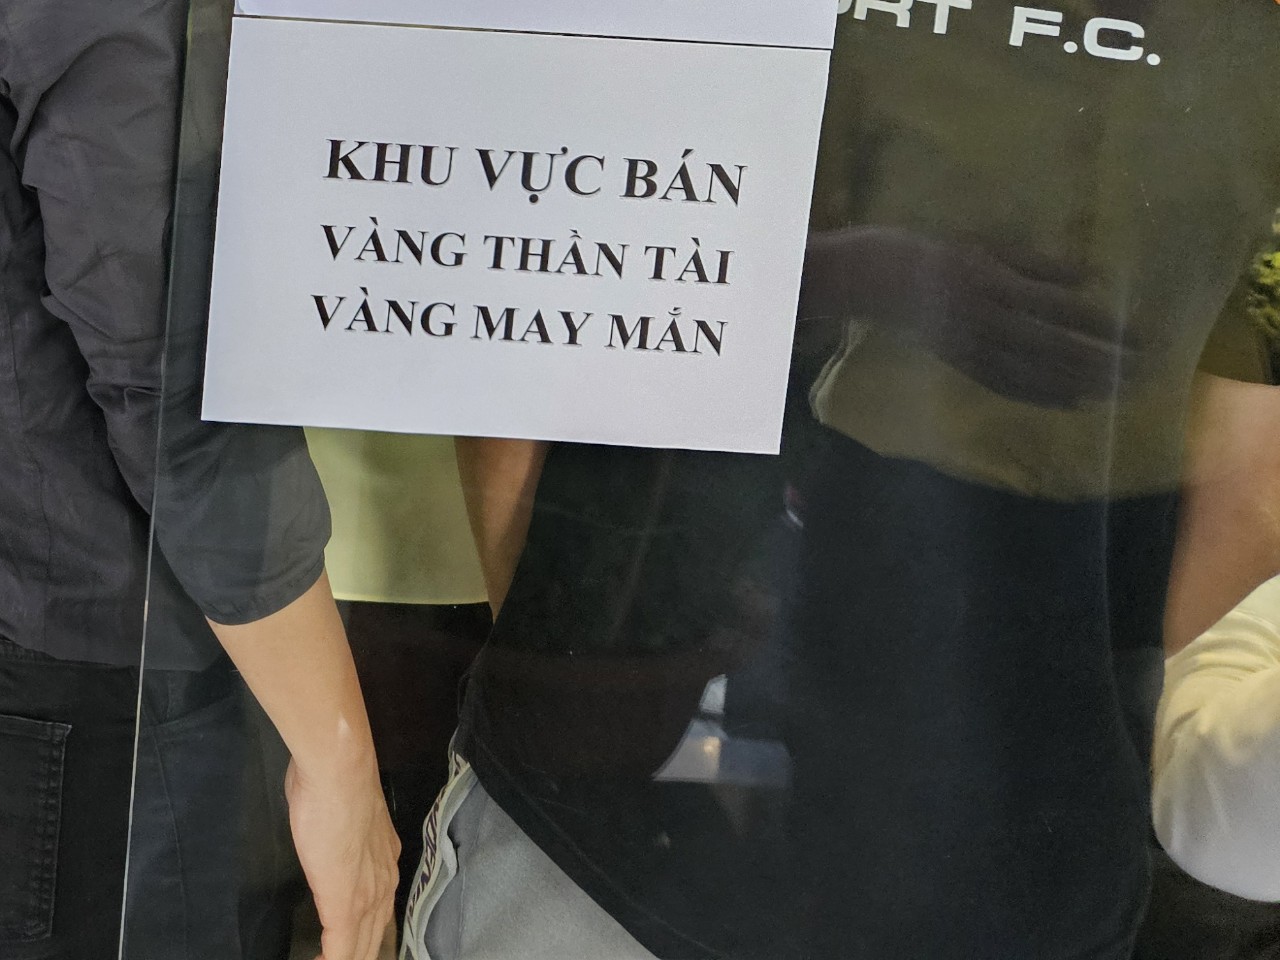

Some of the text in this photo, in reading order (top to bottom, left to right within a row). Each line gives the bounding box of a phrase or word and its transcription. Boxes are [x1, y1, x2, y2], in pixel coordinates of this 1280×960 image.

[1008, 5, 1162, 66] F.C.
[322, 138, 749, 207] KHU VỰC BÁN
[319, 215, 735, 285] VÀNG THẦN TÀI
[310, 286, 729, 357] VÀNG MAY MẮN
